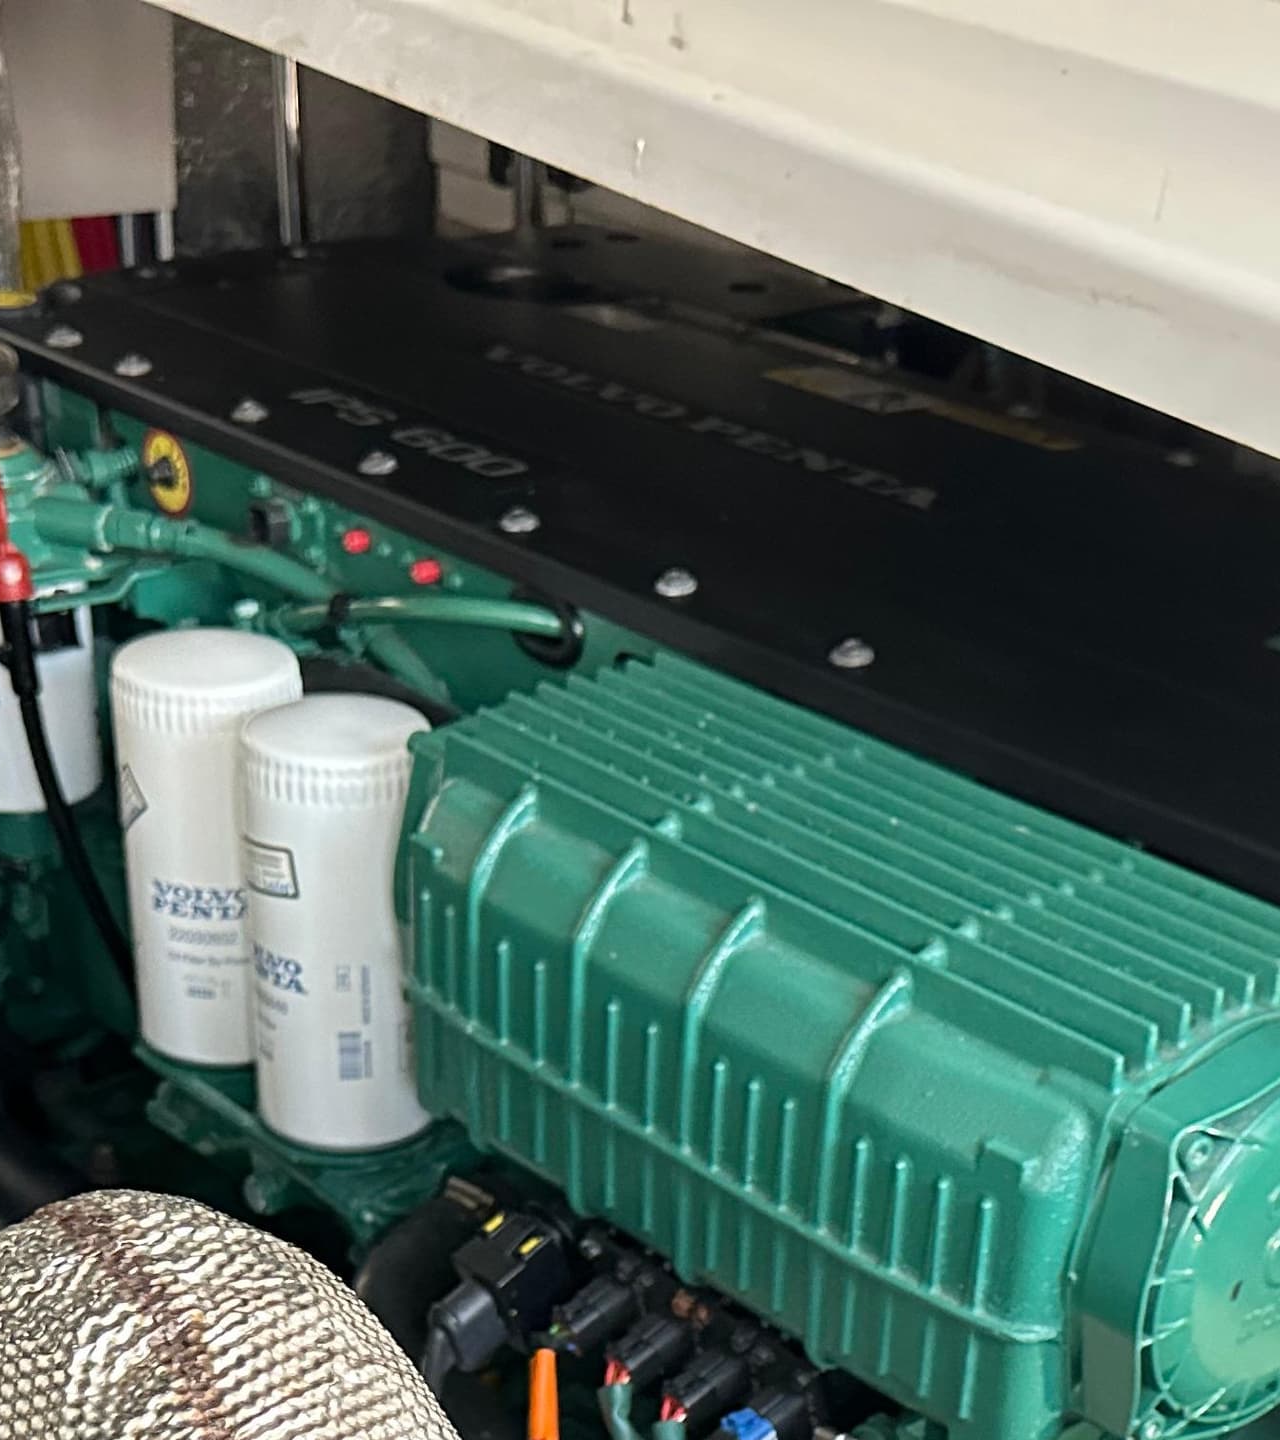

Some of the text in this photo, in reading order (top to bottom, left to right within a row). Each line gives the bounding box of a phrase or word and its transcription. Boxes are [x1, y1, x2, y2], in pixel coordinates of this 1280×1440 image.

[291, 388, 529, 478] IPS 600
[486, 344, 938, 511] VOLVO PENTA
[154, 880, 247, 902] VOLVO
